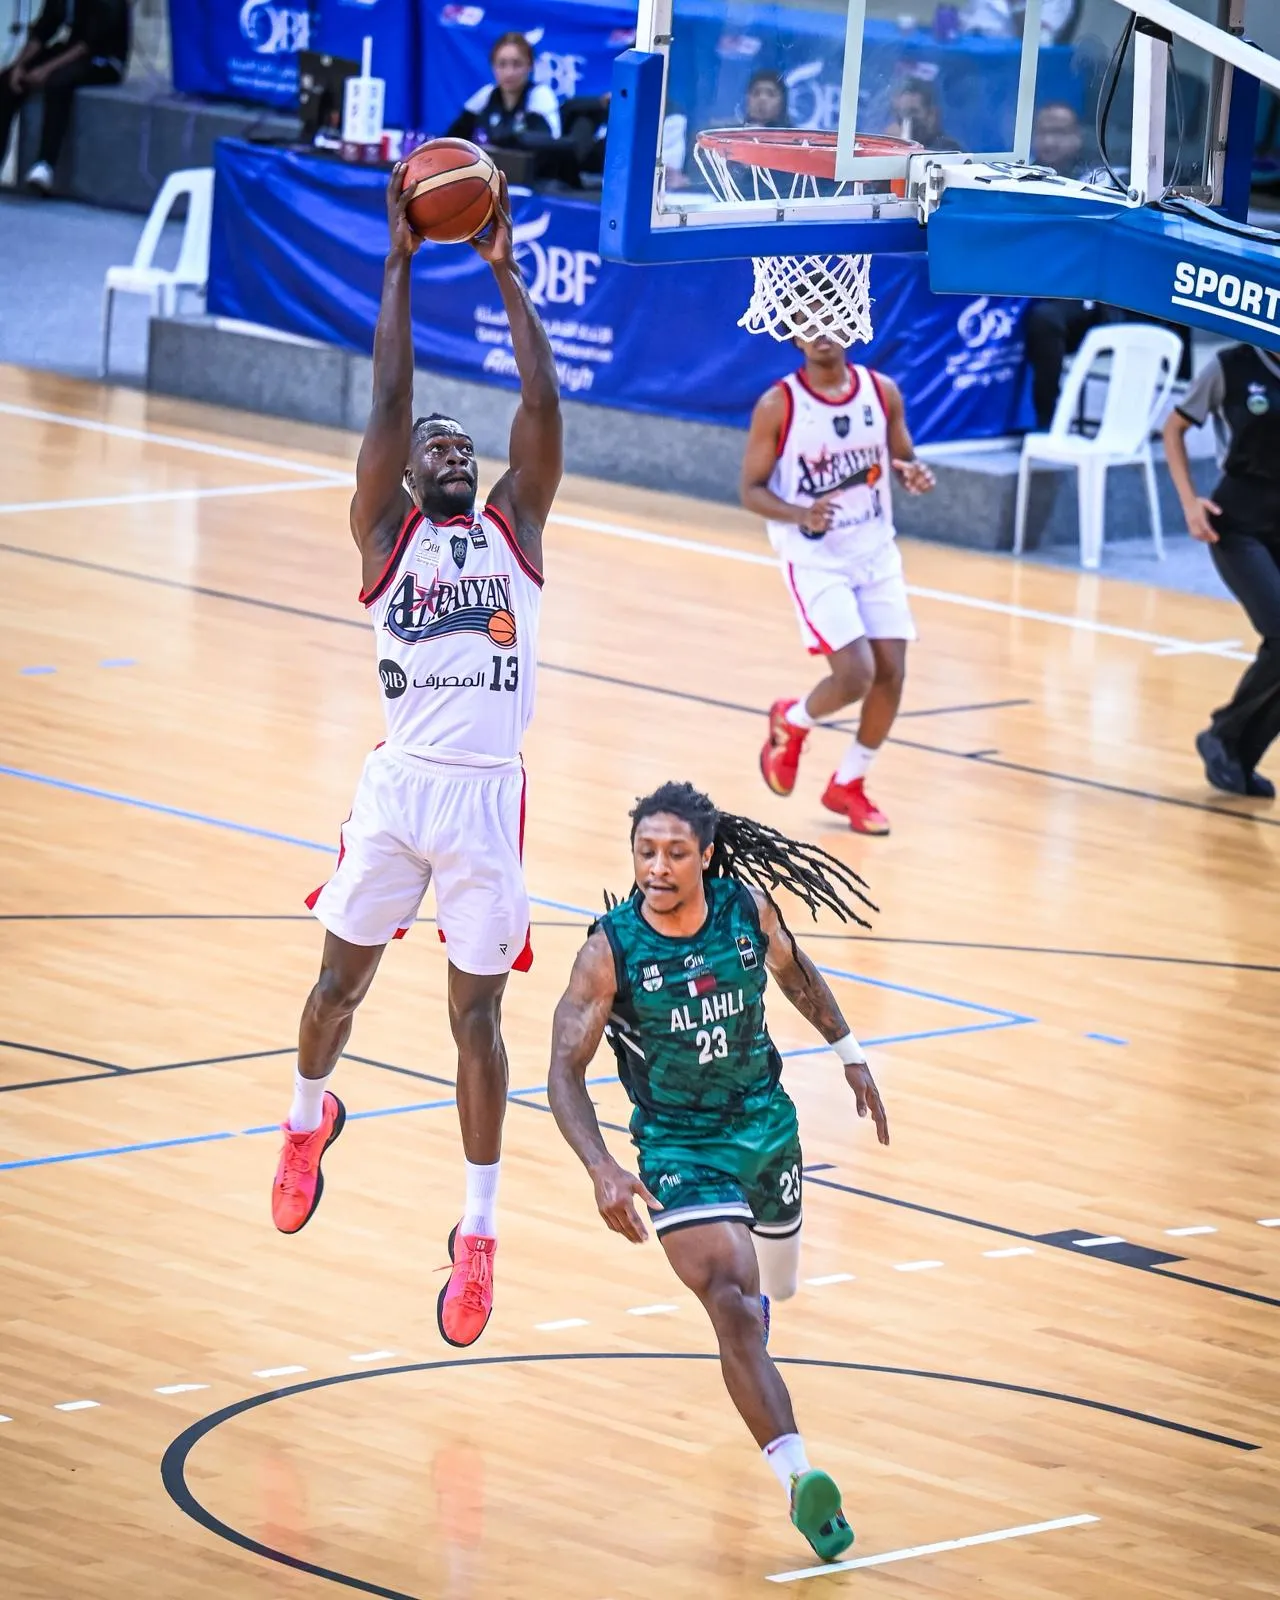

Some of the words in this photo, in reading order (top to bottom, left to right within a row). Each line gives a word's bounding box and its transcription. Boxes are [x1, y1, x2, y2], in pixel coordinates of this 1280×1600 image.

[413, 672, 485, 690] المصرف
[490, 656, 518, 692] 13
[670, 1005, 698, 1032] AL
[702, 989, 745, 1025] AHLI
[696, 1026, 729, 1065] 23
[779, 1164, 800, 1206] 23
